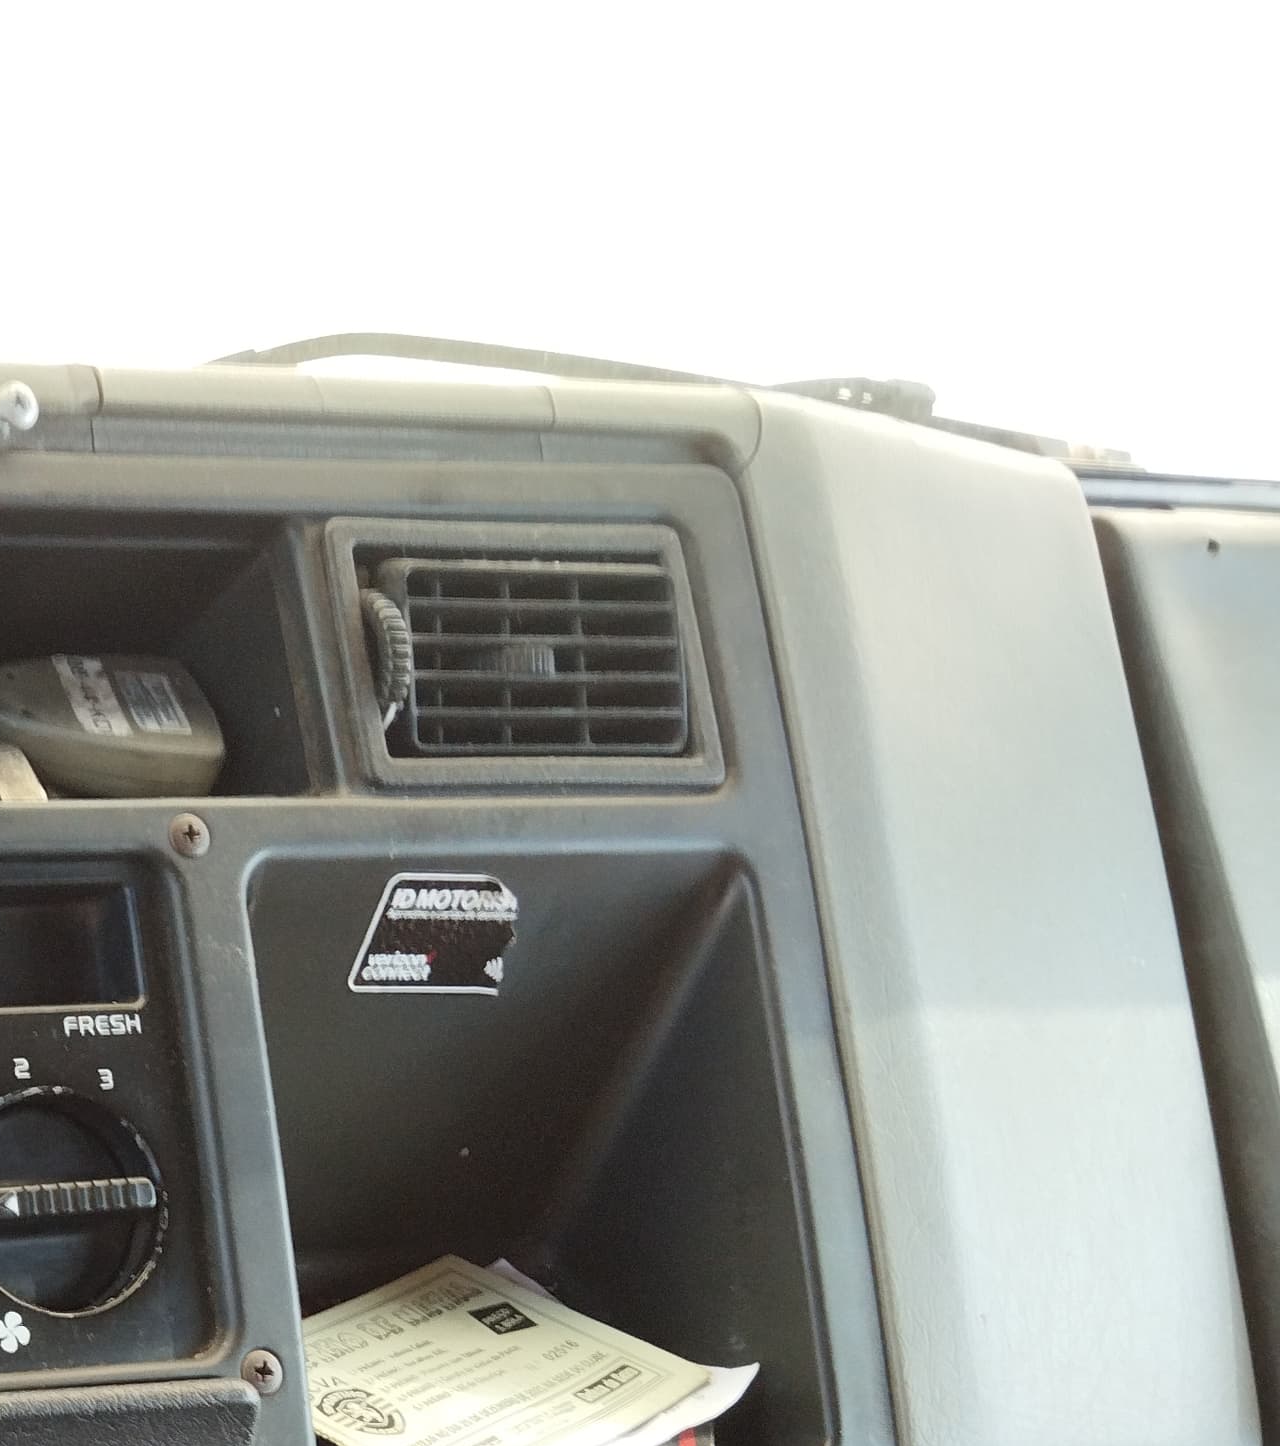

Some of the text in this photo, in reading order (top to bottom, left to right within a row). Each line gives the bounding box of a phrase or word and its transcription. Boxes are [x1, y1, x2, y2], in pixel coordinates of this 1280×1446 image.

[63, 1014, 142, 1037] FRESH
[13, 1057, 31, 1079] 2
[98, 1068, 114, 1090] 3
[542, 1338, 580, 1361] 02516
